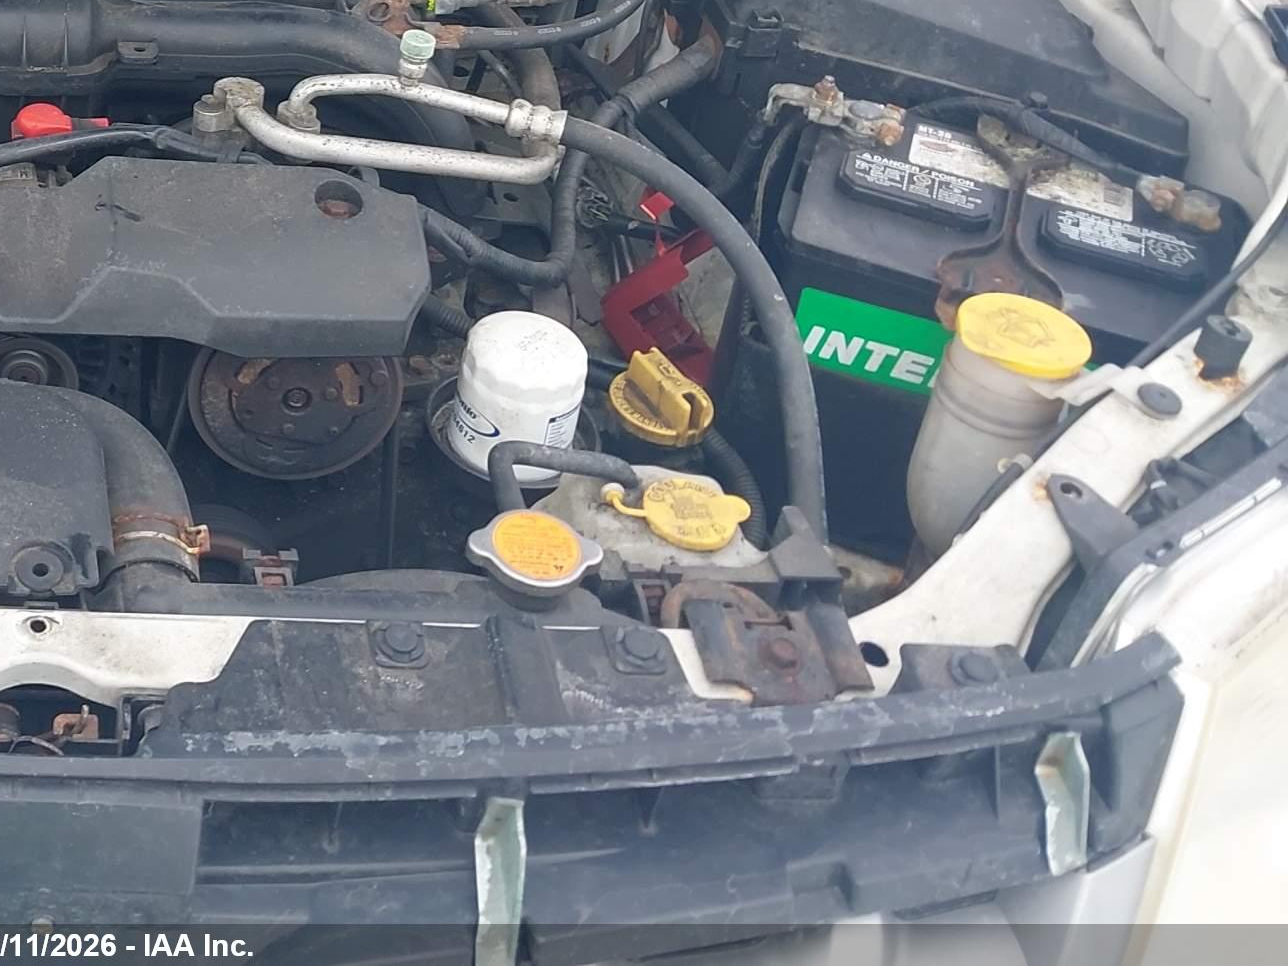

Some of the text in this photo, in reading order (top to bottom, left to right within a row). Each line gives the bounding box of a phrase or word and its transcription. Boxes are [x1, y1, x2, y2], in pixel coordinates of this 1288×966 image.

[869, 153, 920, 174] DANGER
[931, 171, 976, 187] POISON
[802, 325, 938, 388] INTE
